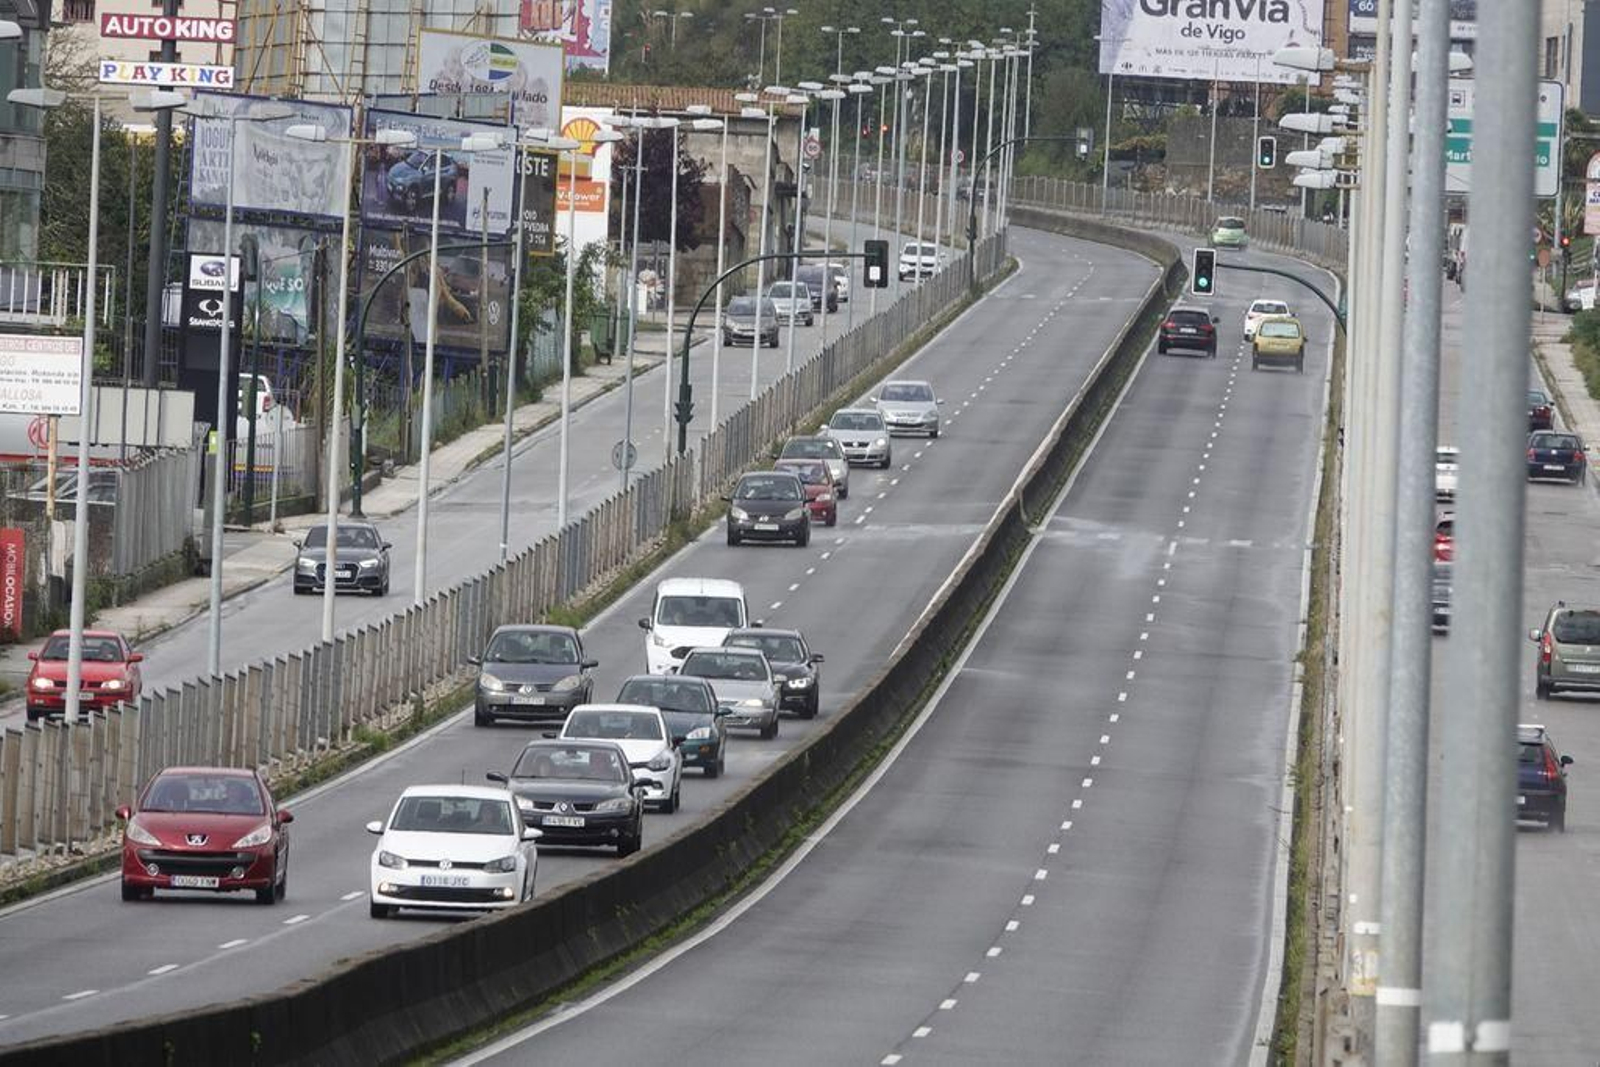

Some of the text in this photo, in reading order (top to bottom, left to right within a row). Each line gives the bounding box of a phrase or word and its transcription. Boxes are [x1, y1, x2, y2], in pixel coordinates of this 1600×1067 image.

[105, 17, 233, 40] AUTO KING
[1181, 22, 1246, 44] de Vigo
[103, 63, 230, 84] PLAY KING
[266, 277, 303, 293] QUESO
